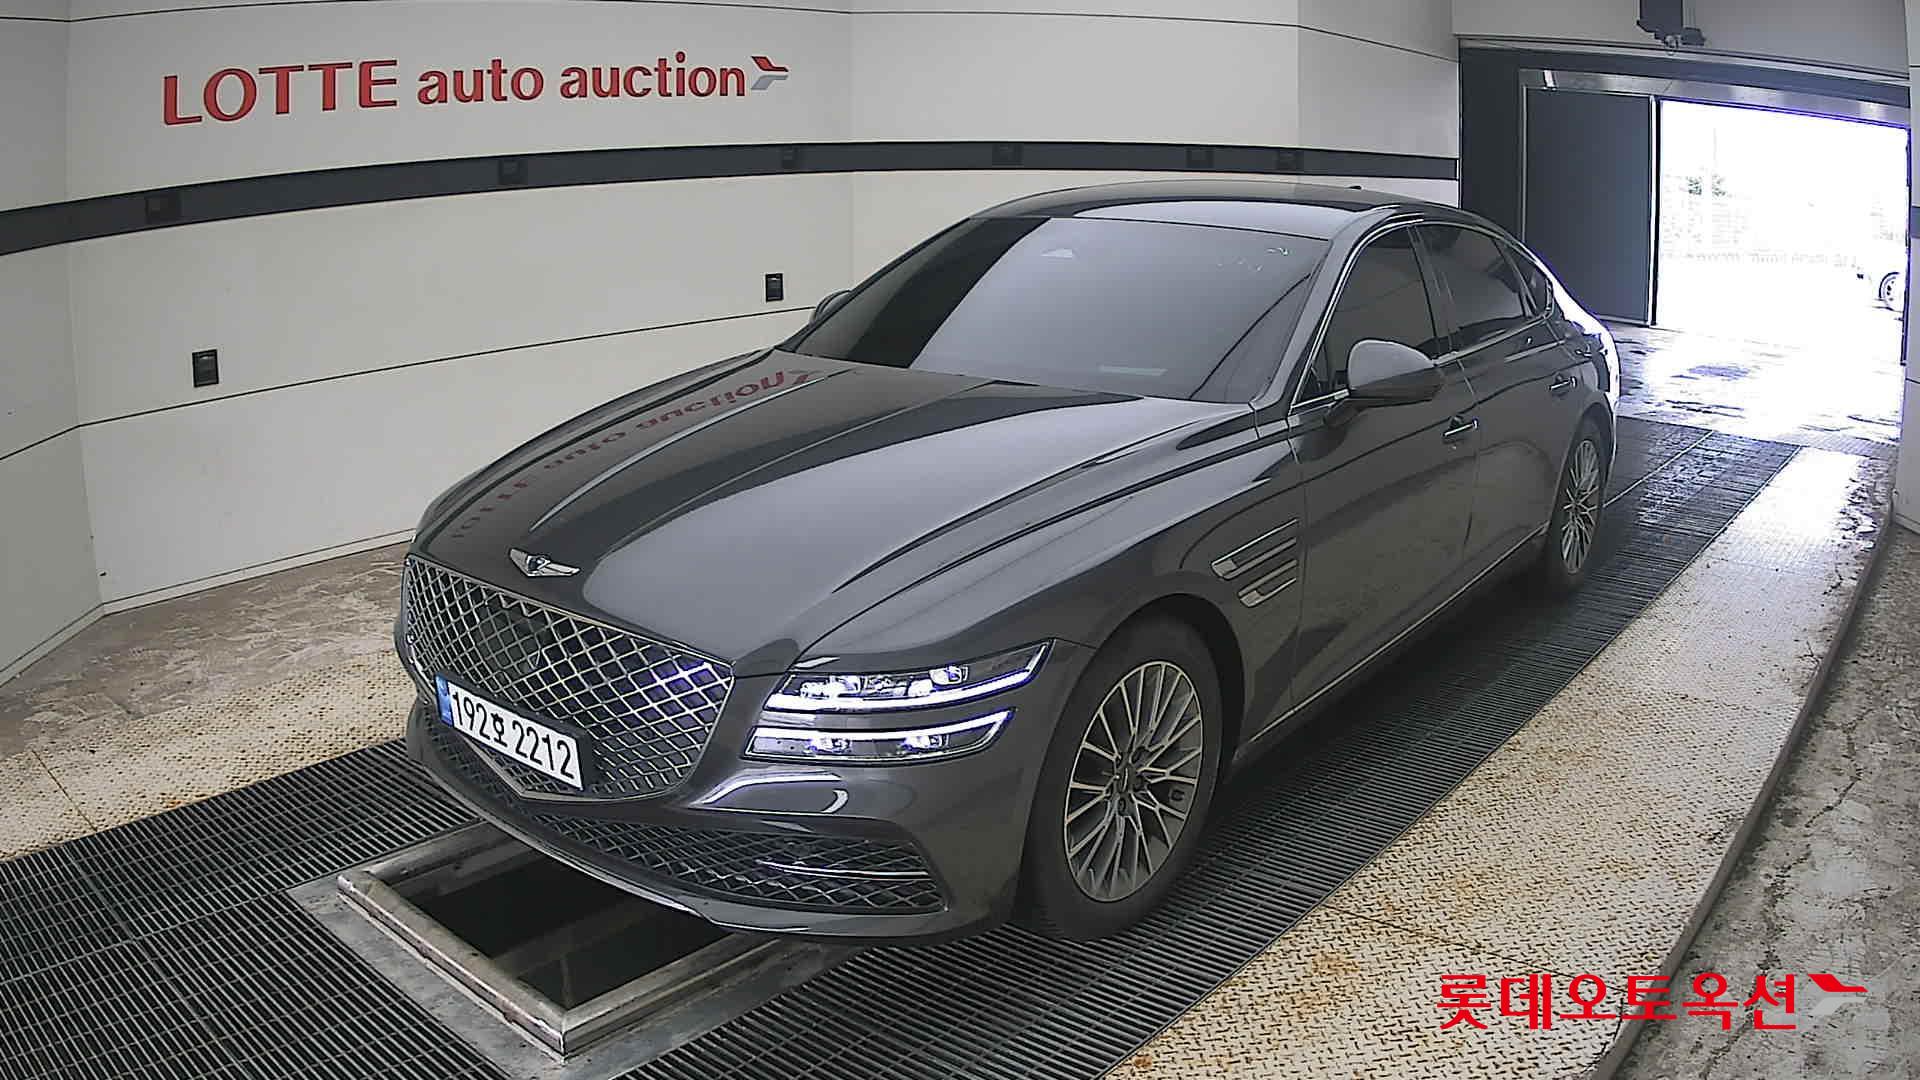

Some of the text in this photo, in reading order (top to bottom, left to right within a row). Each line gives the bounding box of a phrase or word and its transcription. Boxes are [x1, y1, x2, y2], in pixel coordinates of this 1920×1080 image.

[163, 51, 747, 126] LOTTE auto auction
[452, 691, 576, 780] 192호 2212
